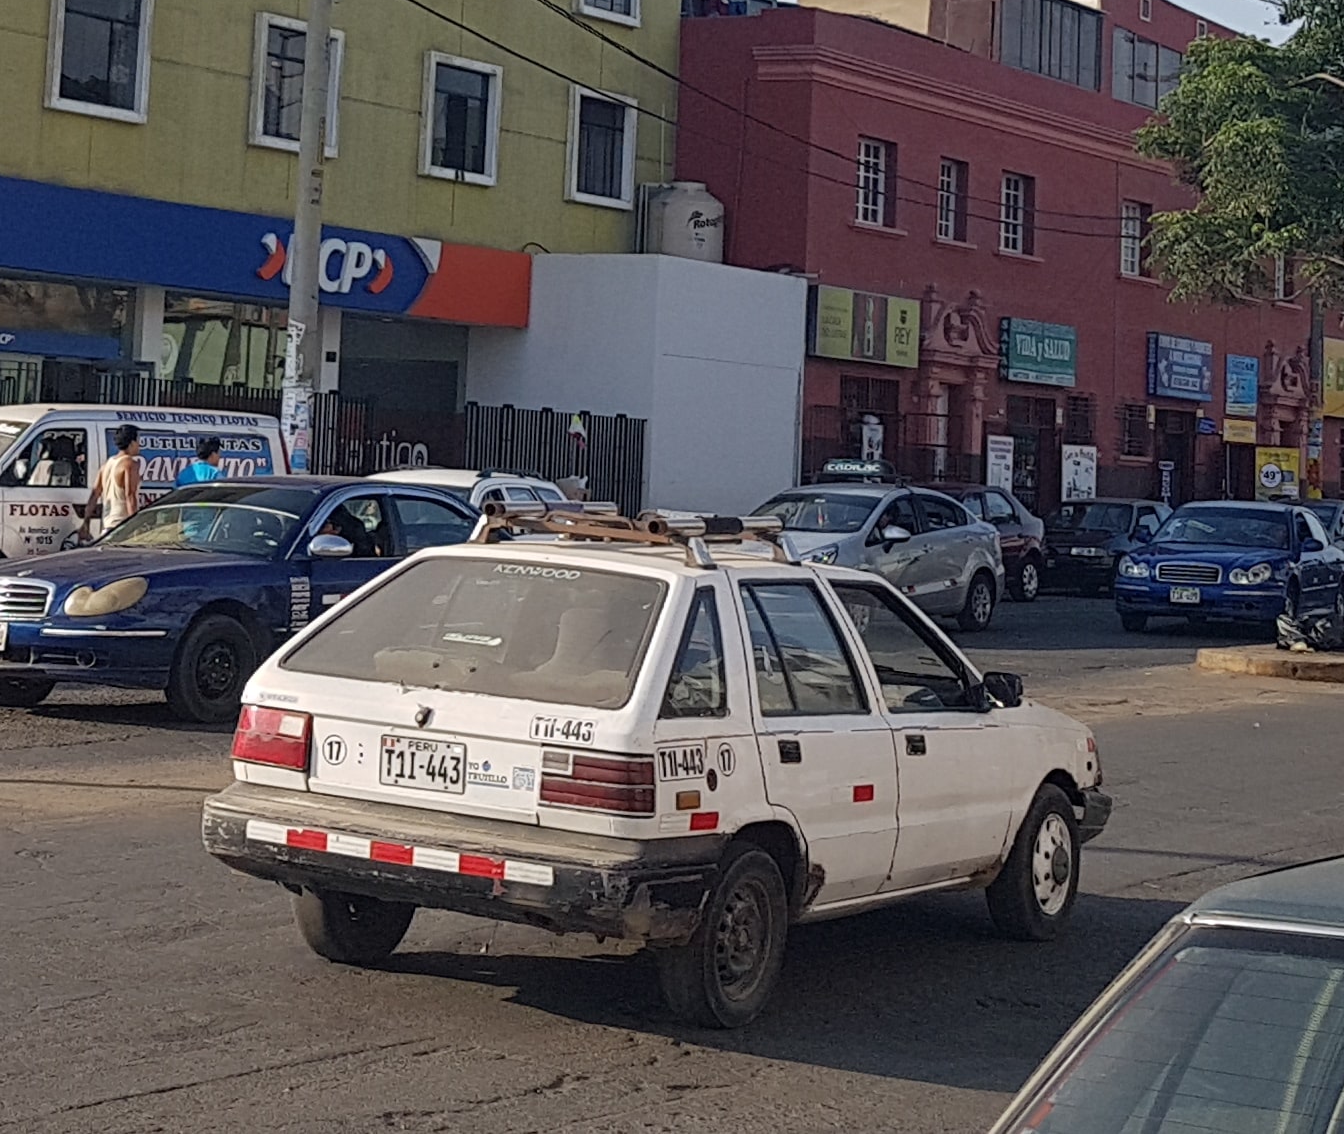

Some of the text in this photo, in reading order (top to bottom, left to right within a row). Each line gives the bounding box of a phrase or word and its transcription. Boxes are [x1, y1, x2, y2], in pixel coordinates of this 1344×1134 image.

[894, 326, 911, 346] REY
[116, 411, 167, 422] SERVICIO
[219, 415, 259, 427] FLOTAS
[9, 503, 71, 517] FLOTAS
[493, 564, 581, 580] KENWOOD
[327, 741, 341, 760] 17
[408, 741, 438, 753] PERU
[720, 748, 731, 772] 17
